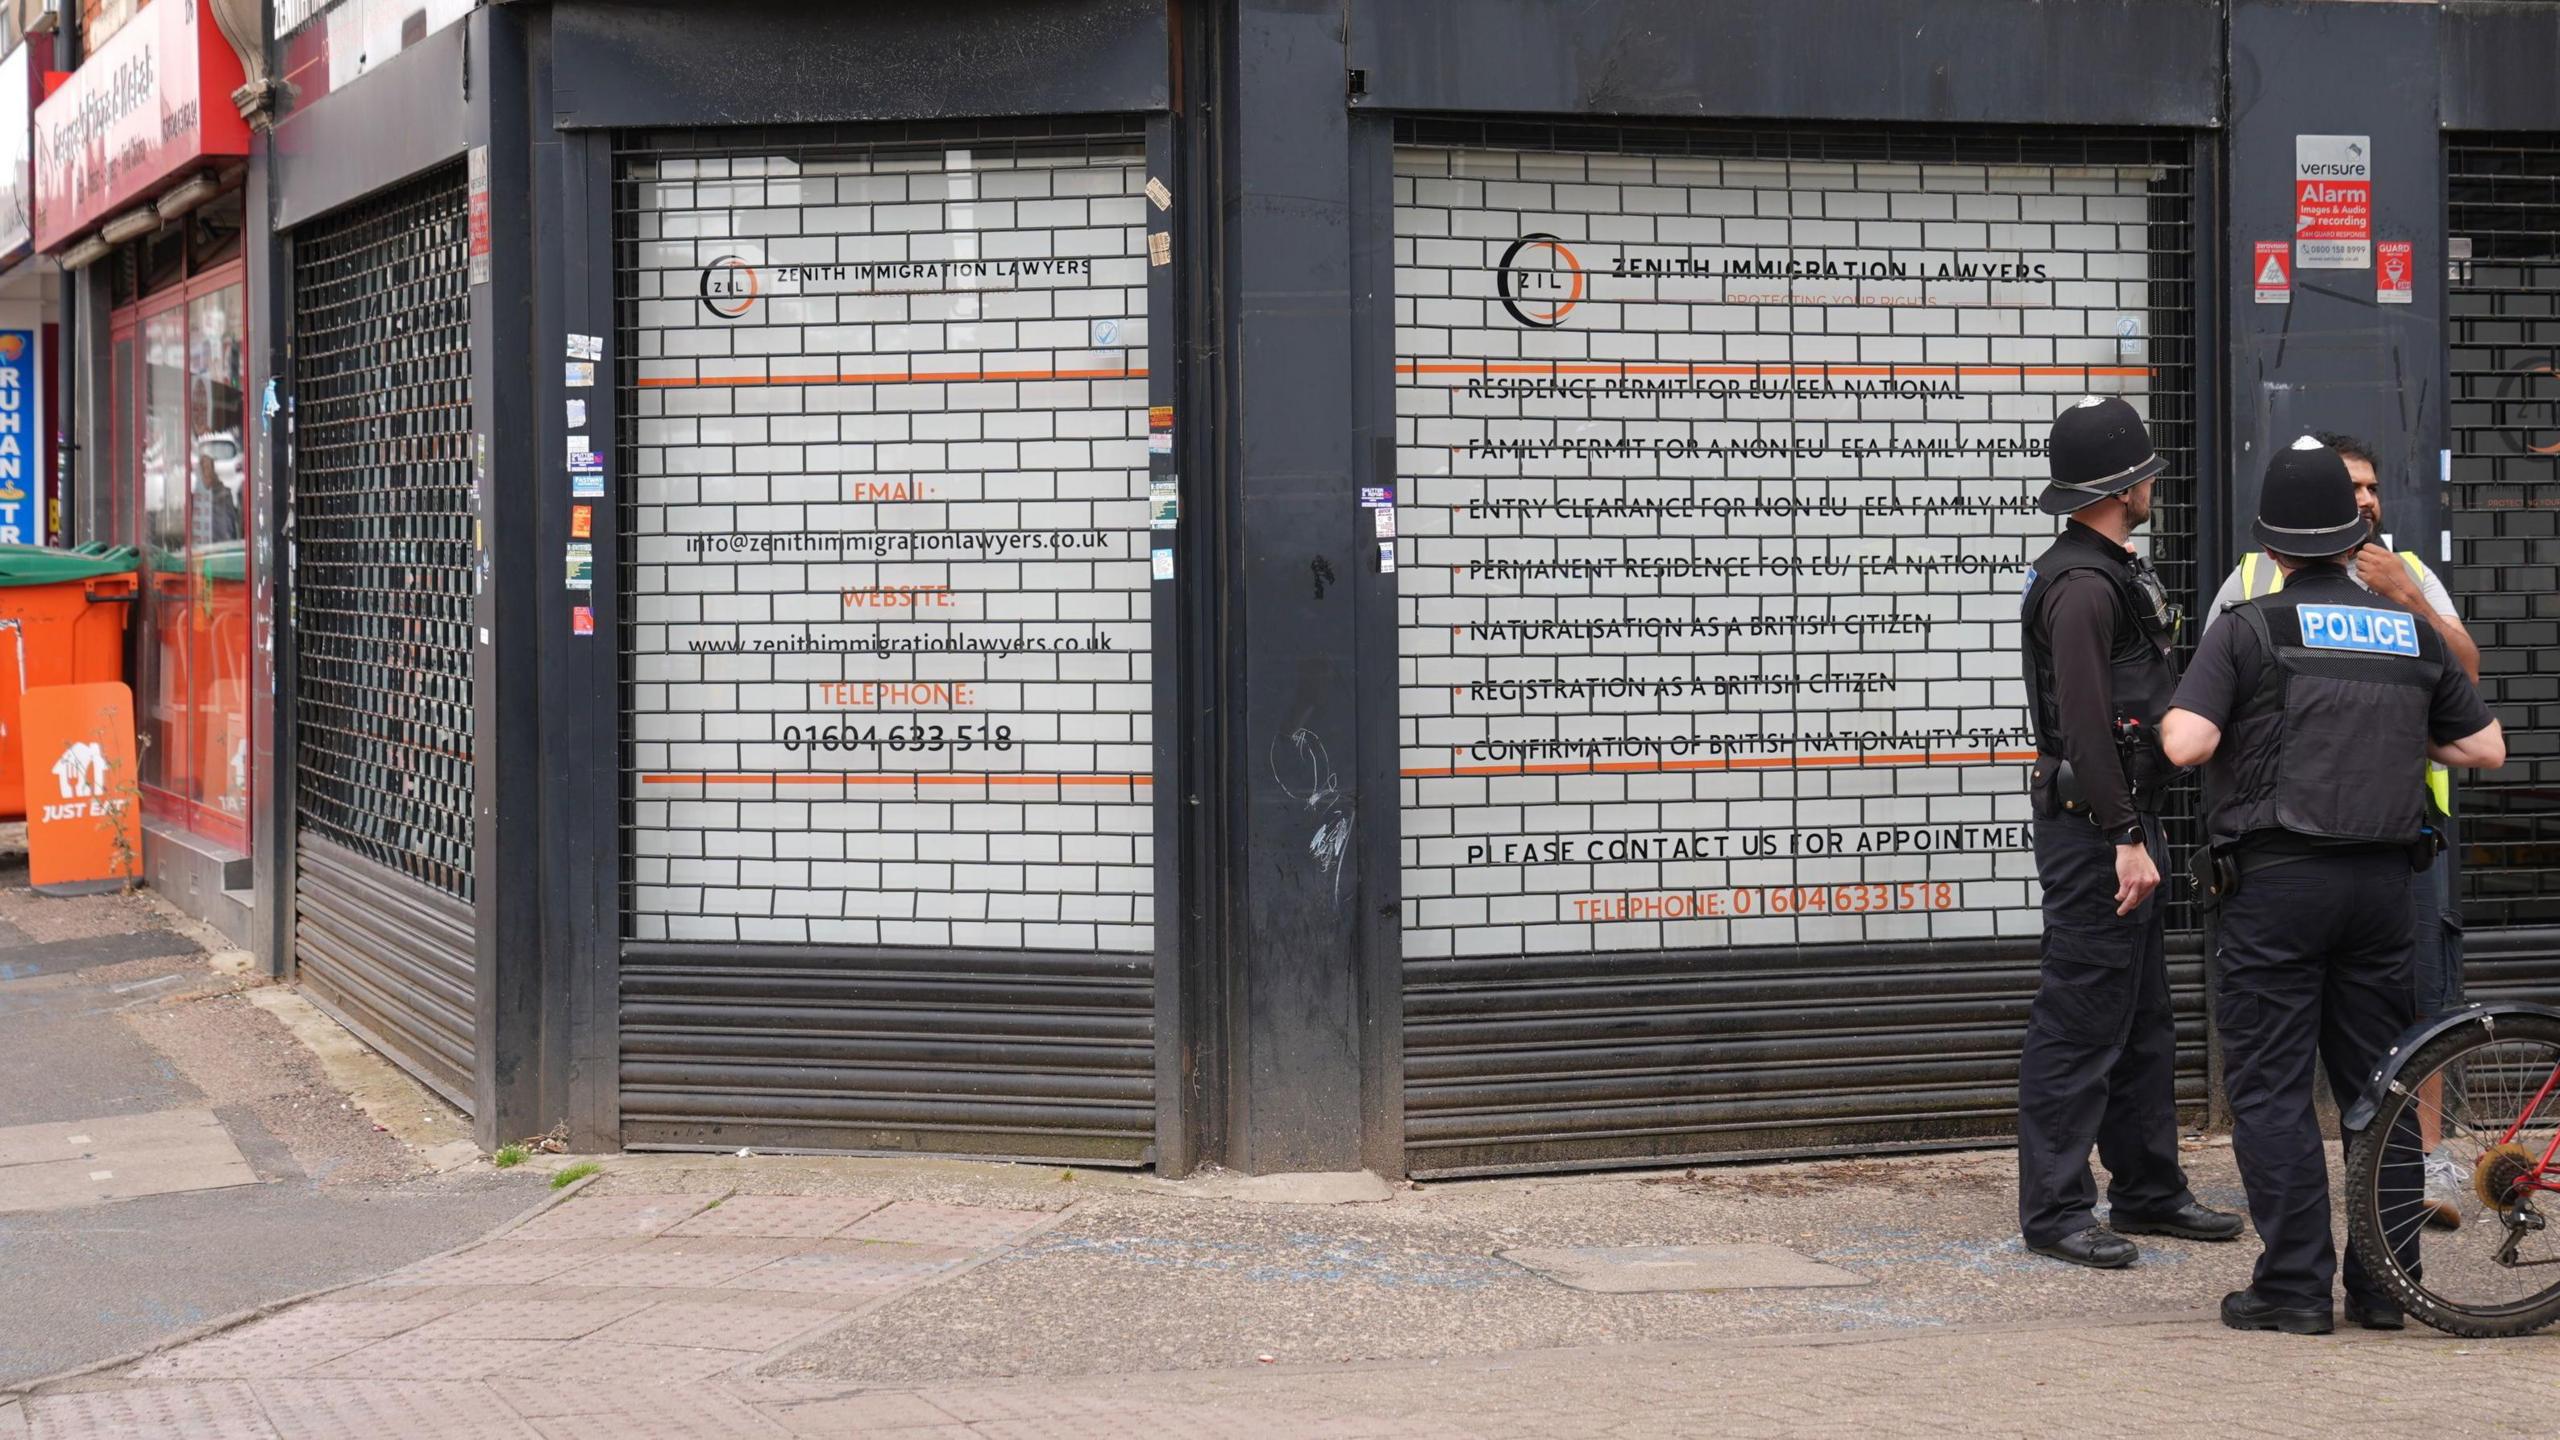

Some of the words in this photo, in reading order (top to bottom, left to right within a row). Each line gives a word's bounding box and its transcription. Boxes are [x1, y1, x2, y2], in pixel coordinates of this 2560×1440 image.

[2301, 163, 2366, 176] verisure
[2301, 183, 2367, 203] Alarm
[2301, 205, 2331, 216] Images
[2332, 205, 2340, 214] &
[2342, 205, 2366, 214] Audio
[2318, 216, 2367, 229] recording
[2311, 246, 2331, 254] 0800
[2379, 243, 2410, 253] GUARD
[777, 266, 846, 282] ZENITH
[855, 263, 987, 280] IMMIGRATION
[996, 260, 1090, 276] LAWYERS
[1519, 272, 1562, 289] ZIL
[1612, 258, 1710, 279] ZENITH
[1723, 259, 1907, 281] IMMIGRATION
[1920, 262, 2047, 284] LAWYERS
[714, 280, 743, 293] ZIL
[1467, 377, 1597, 400] RESIDENCE
[1605, 378, 1688, 400] PERMIT
[1697, 379, 1741, 400] FOR
[1845, 379, 1965, 400] NATIONAL
[1468, 438, 1555, 460] FAMILY
[1562, 438, 1646, 459] PERMIT
[1654, 438, 1701, 459] FOR
[1707, 438, 1726, 459] A
[1731, 438, 1787, 459] NON
[1795, 438, 1824, 459] EU
[1841, 438, 1881, 458] EEA
[1890, 438, 1969, 458] FAMILY
[855, 482, 935, 502] EMAIL:
[1469, 498, 1547, 519] ENTRY
[1556, 497, 1693, 518] CLEARANCE
[1701, 497, 1746, 518] FOR
[1755, 496, 1811, 517] NON
[1819, 496, 1847, 517] EU
[1865, 496, 1904, 516] EEA
[1912, 496, 1992, 516] FAMILY
[686, 532, 1109, 556] info@zenithimmigrationlawyers.co.uk
[1470, 558, 1617, 580] PERMANENT
[1625, 557, 1750, 578] RESIDENCE
[1759, 556, 1802, 577] FOR
[1812, 555, 1851, 577] EU/
[1859, 555, 1898, 576] EEA
[1906, 554, 2025, 575] NATIONAL
[841, 585, 956, 608] WEBSITE:
[1470, 617, 1683, 641] NATURALISATION
[1691, 616, 1719, 638] AS
[1727, 616, 1743, 637] A
[1750, 615, 1836, 636] BRITISH
[1844, 613, 1932, 635] CITIZEN
[2304, 611, 2414, 648] POLICE
[689, 631, 1113, 659] wwwzenithimmigrationlawyers.co.uk
[820, 682, 975, 706] TELEPHONE:
[1471, 676, 1645, 701] REGISTRATION
[1654, 676, 1683, 697] AS
[1691, 676, 1706, 696] A
[1714, 674, 1800, 696] BRITISH
[1809, 672, 1896, 694] CITIZEN
[783, 724, 877, 752] 01604
[888, 724, 945, 752] 633
[956, 724, 1013, 752] 518
[1471, 736, 1662, 762] CONFIRMATION
[1671, 735, 1701, 756] OF
[1709, 733, 1795, 755] BRITISH
[1805, 730, 1962, 752] NATIONALITY
[42, 803, 87, 823] JUST
[89, 800, 126, 817] EAT
[1467, 840, 1575, 865] PLEASE
[1587, 835, 1729, 861] CONTACT
[1742, 834, 1777, 856] US
[1790, 833, 1843, 855] FOR
[1573, 891, 1726, 922] TELEPHONE:
[1733, 885, 1827, 915] 01604
[1834, 883, 1889, 913] 633
[1899, 881, 1952, 910] 518
